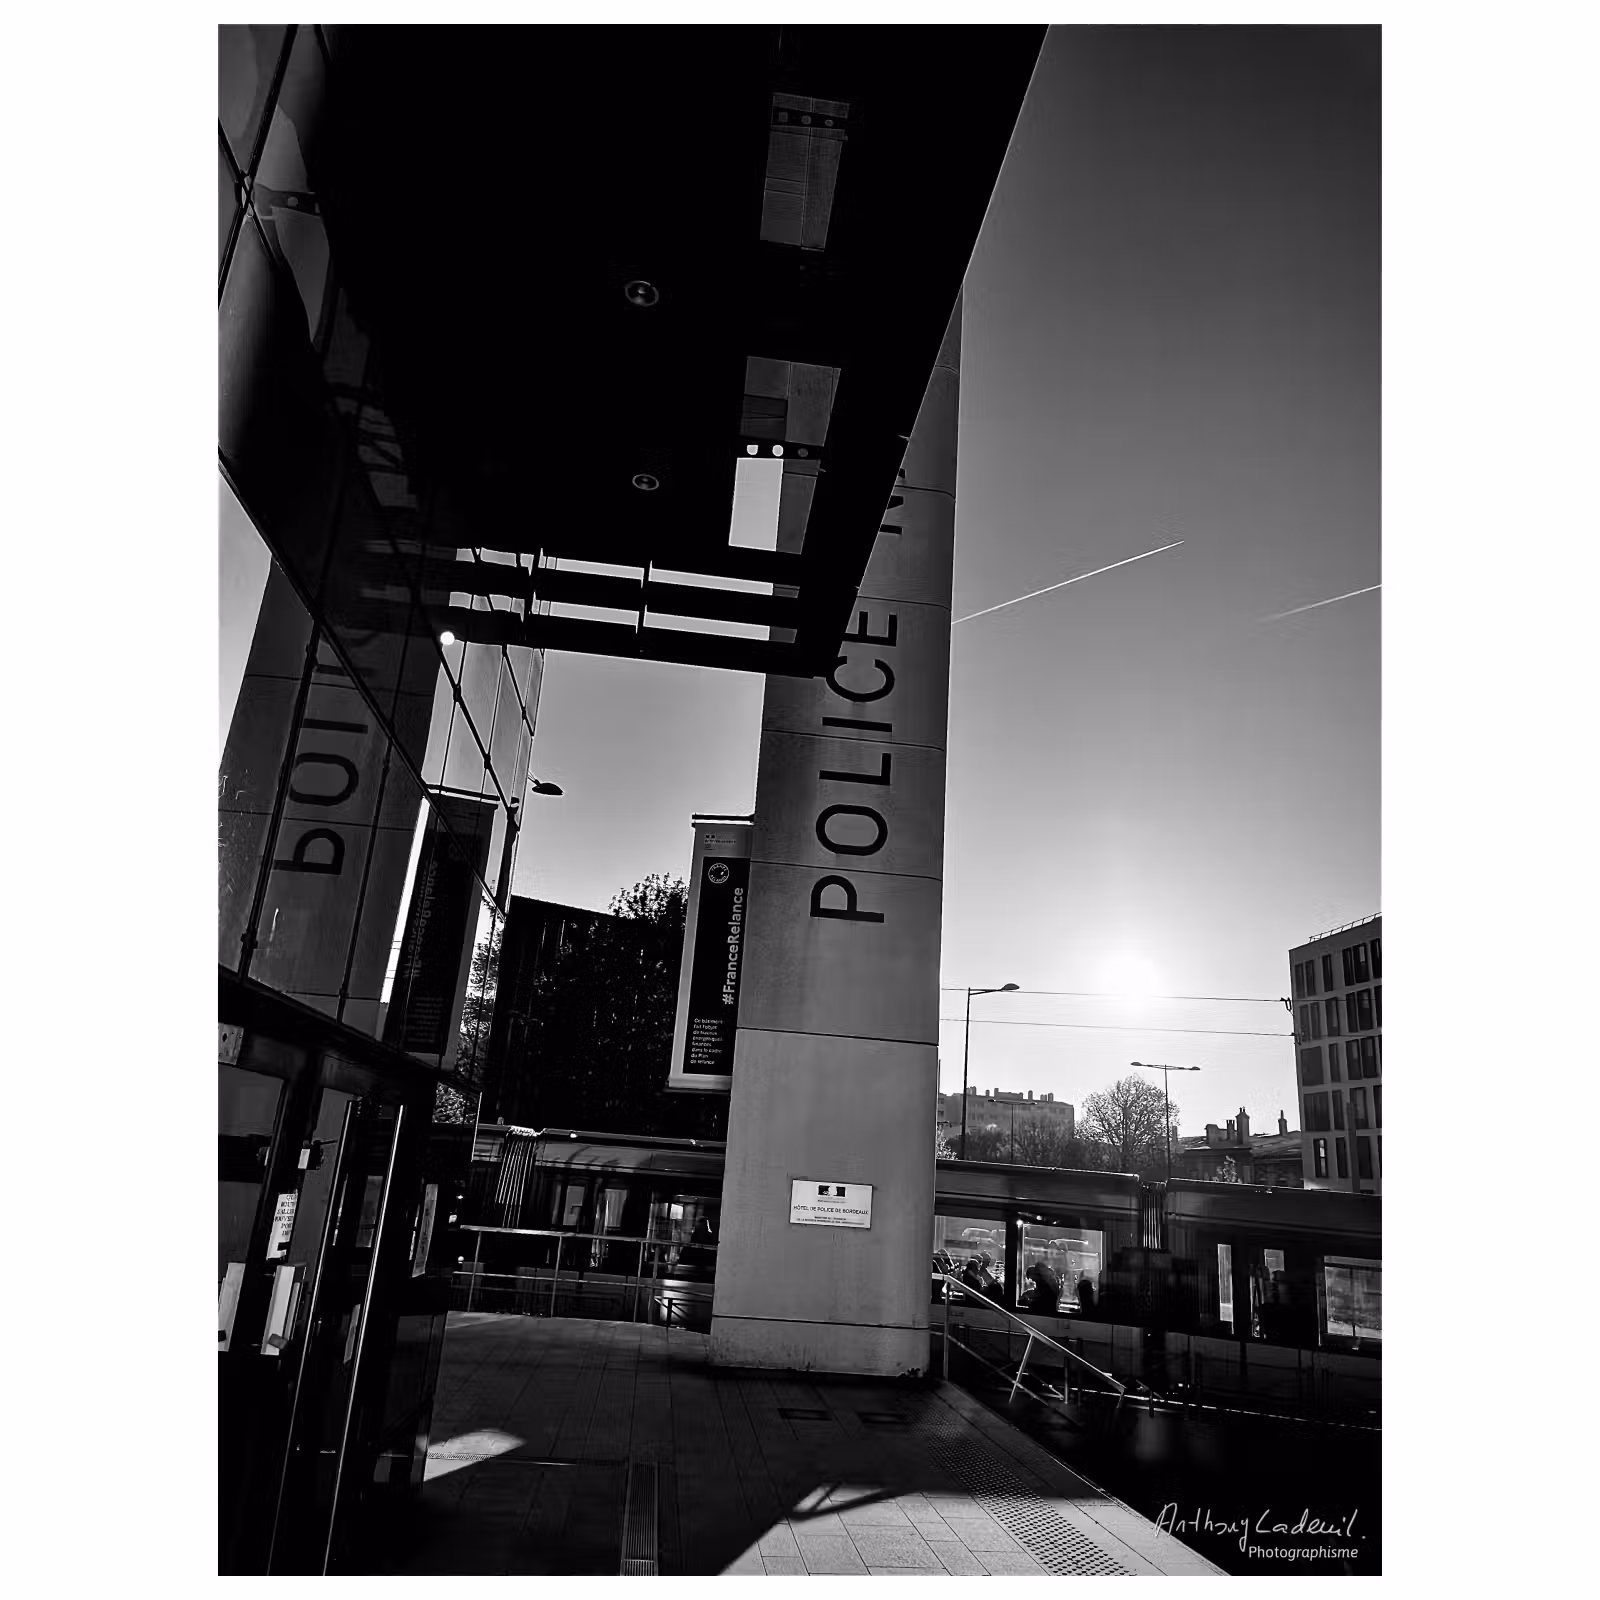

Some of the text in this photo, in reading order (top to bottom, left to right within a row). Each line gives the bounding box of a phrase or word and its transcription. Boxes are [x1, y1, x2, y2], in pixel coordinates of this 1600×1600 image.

[809, 610, 898, 924] POLICE
[722, 887, 744, 1005] #FranceRelance
[793, 1204, 809, 1212] HÔTEL
